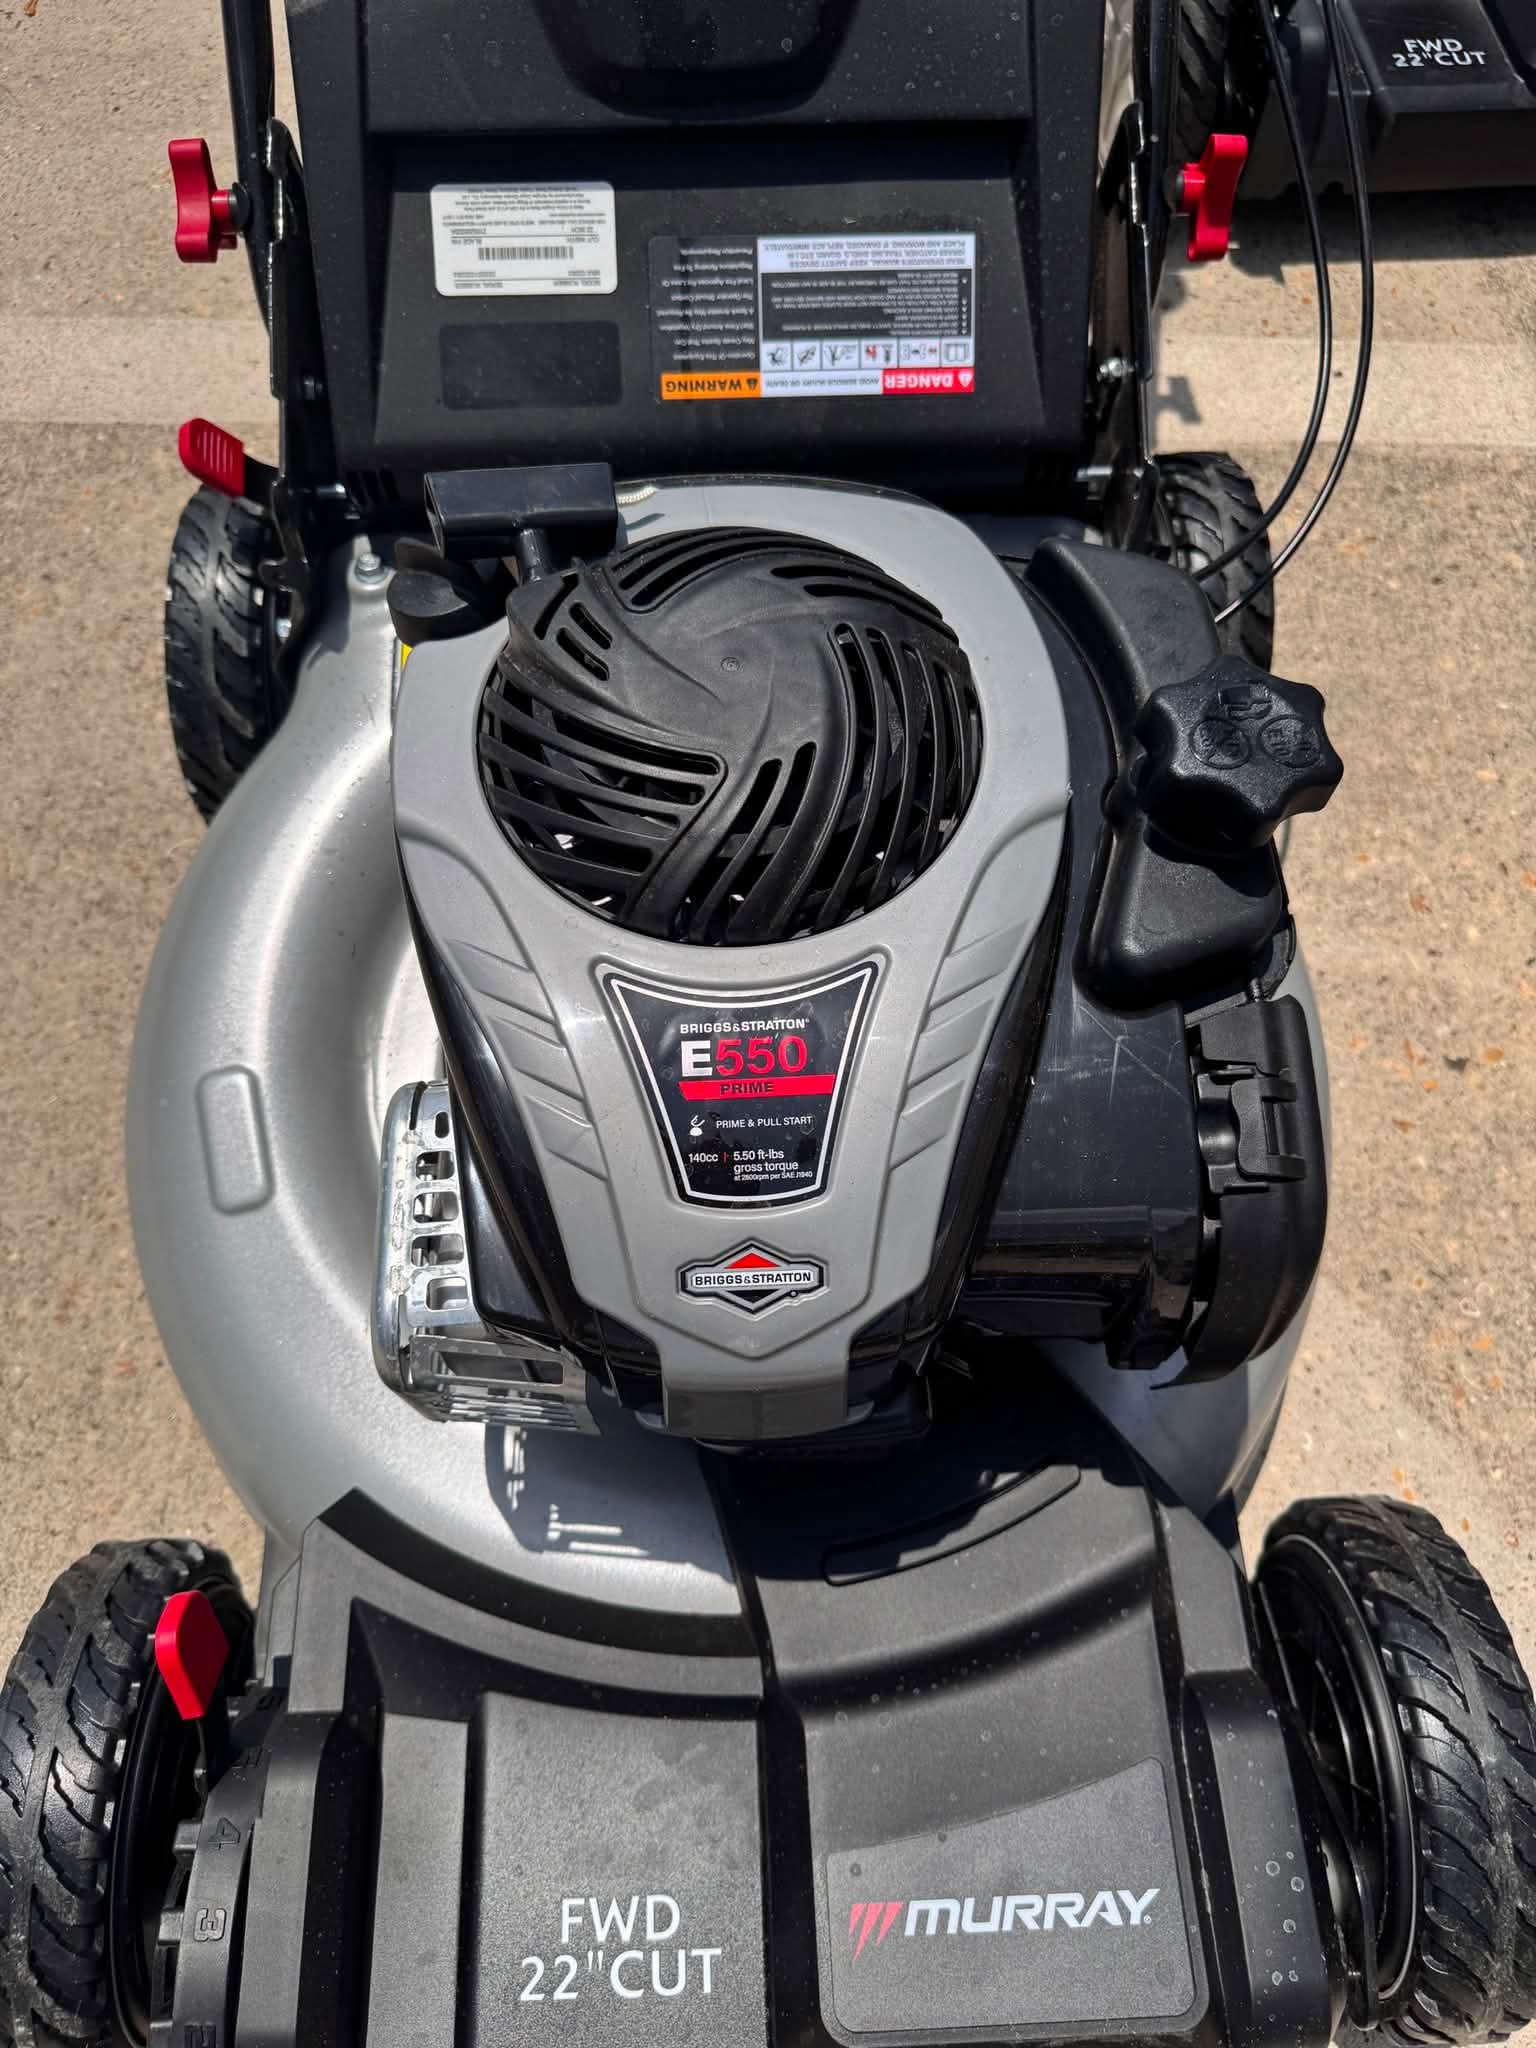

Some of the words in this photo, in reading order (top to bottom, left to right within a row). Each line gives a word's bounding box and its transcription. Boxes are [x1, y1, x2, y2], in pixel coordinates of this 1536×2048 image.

[1403, 38, 1463, 53] FWD
[666, 379, 743, 392] WARNING
[885, 374, 953, 389] DANGER
[681, 1035, 808, 1077] E550
[720, 1081, 774, 1095] PRIME
[716, 1119, 746, 1129] PRIME
[748, 1119, 755, 1127] &
[757, 1118, 781, 1127] PULL
[783, 1116, 813, 1126] START
[688, 1152, 719, 1163] 140cc
[733, 1150, 756, 1161] 5.50
[757, 1149, 784, 1160] ft-lbs
[733, 1164, 763, 1175] gross
[765, 1161, 799, 1173] torque
[782, 1171, 796, 1179] SAE
[695, 1272, 811, 1286] BRIGGS&STRATTON
[561, 1894, 681, 1943] FWD
[905, 1888, 1160, 1936] MURRAY
[194, 1908, 227, 1942] 3
[520, 1947, 722, 2001] 22"CUT
